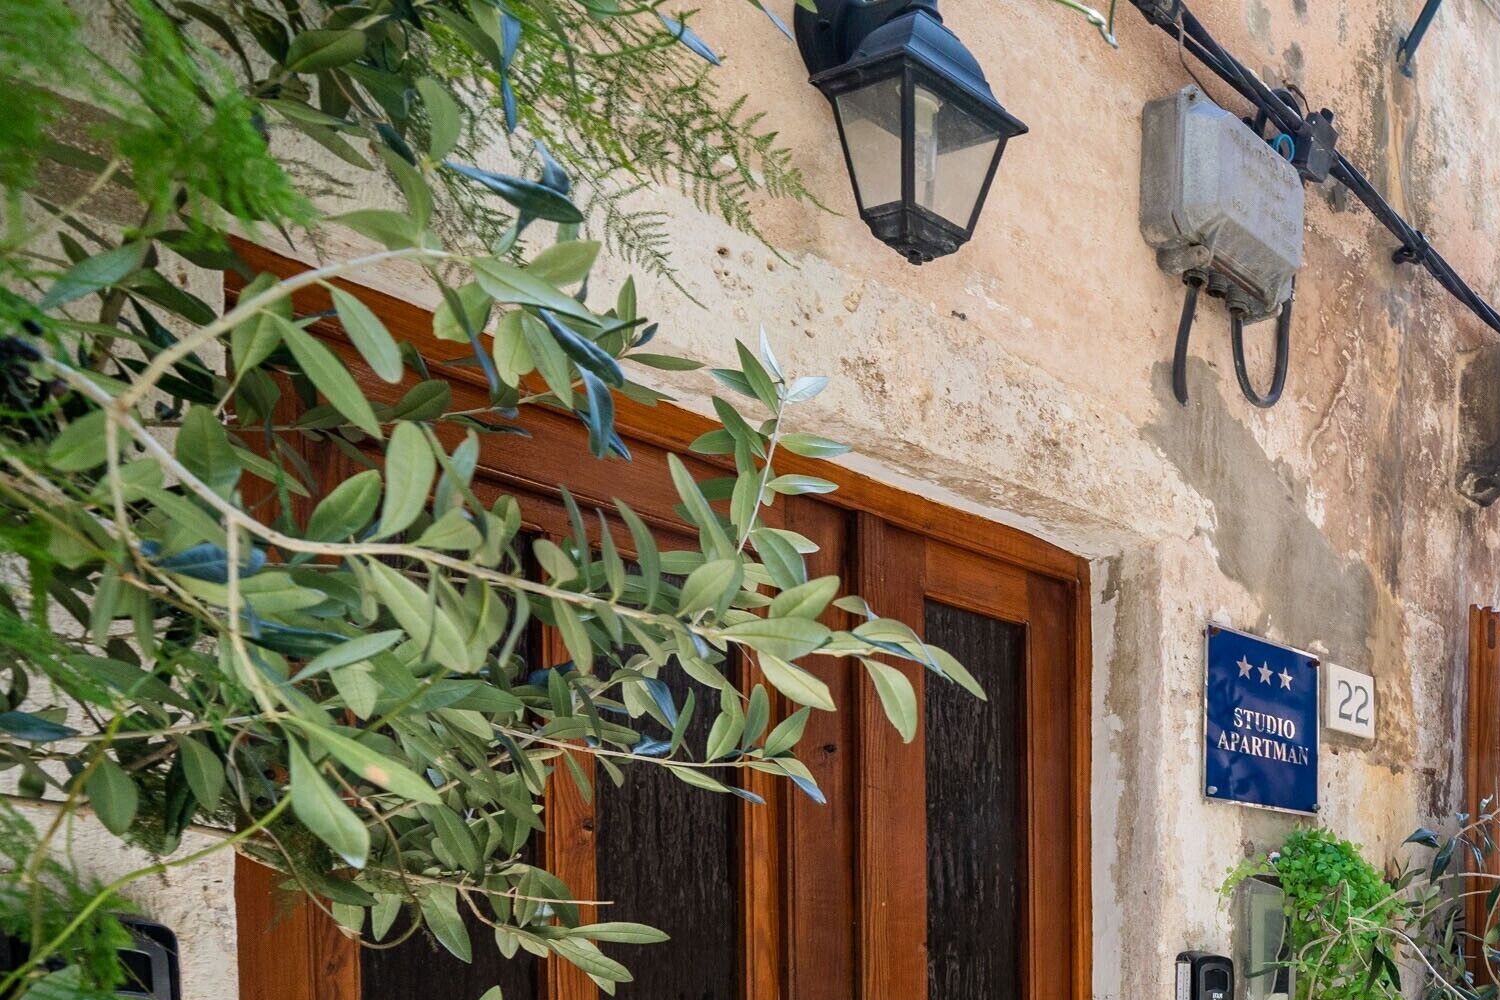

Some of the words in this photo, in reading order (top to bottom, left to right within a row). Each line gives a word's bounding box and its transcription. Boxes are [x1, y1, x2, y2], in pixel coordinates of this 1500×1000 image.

[1338, 680, 1369, 726] 22
[1233, 707, 1296, 740] STUDIO
[1217, 729, 1309, 766] APARTMAN
